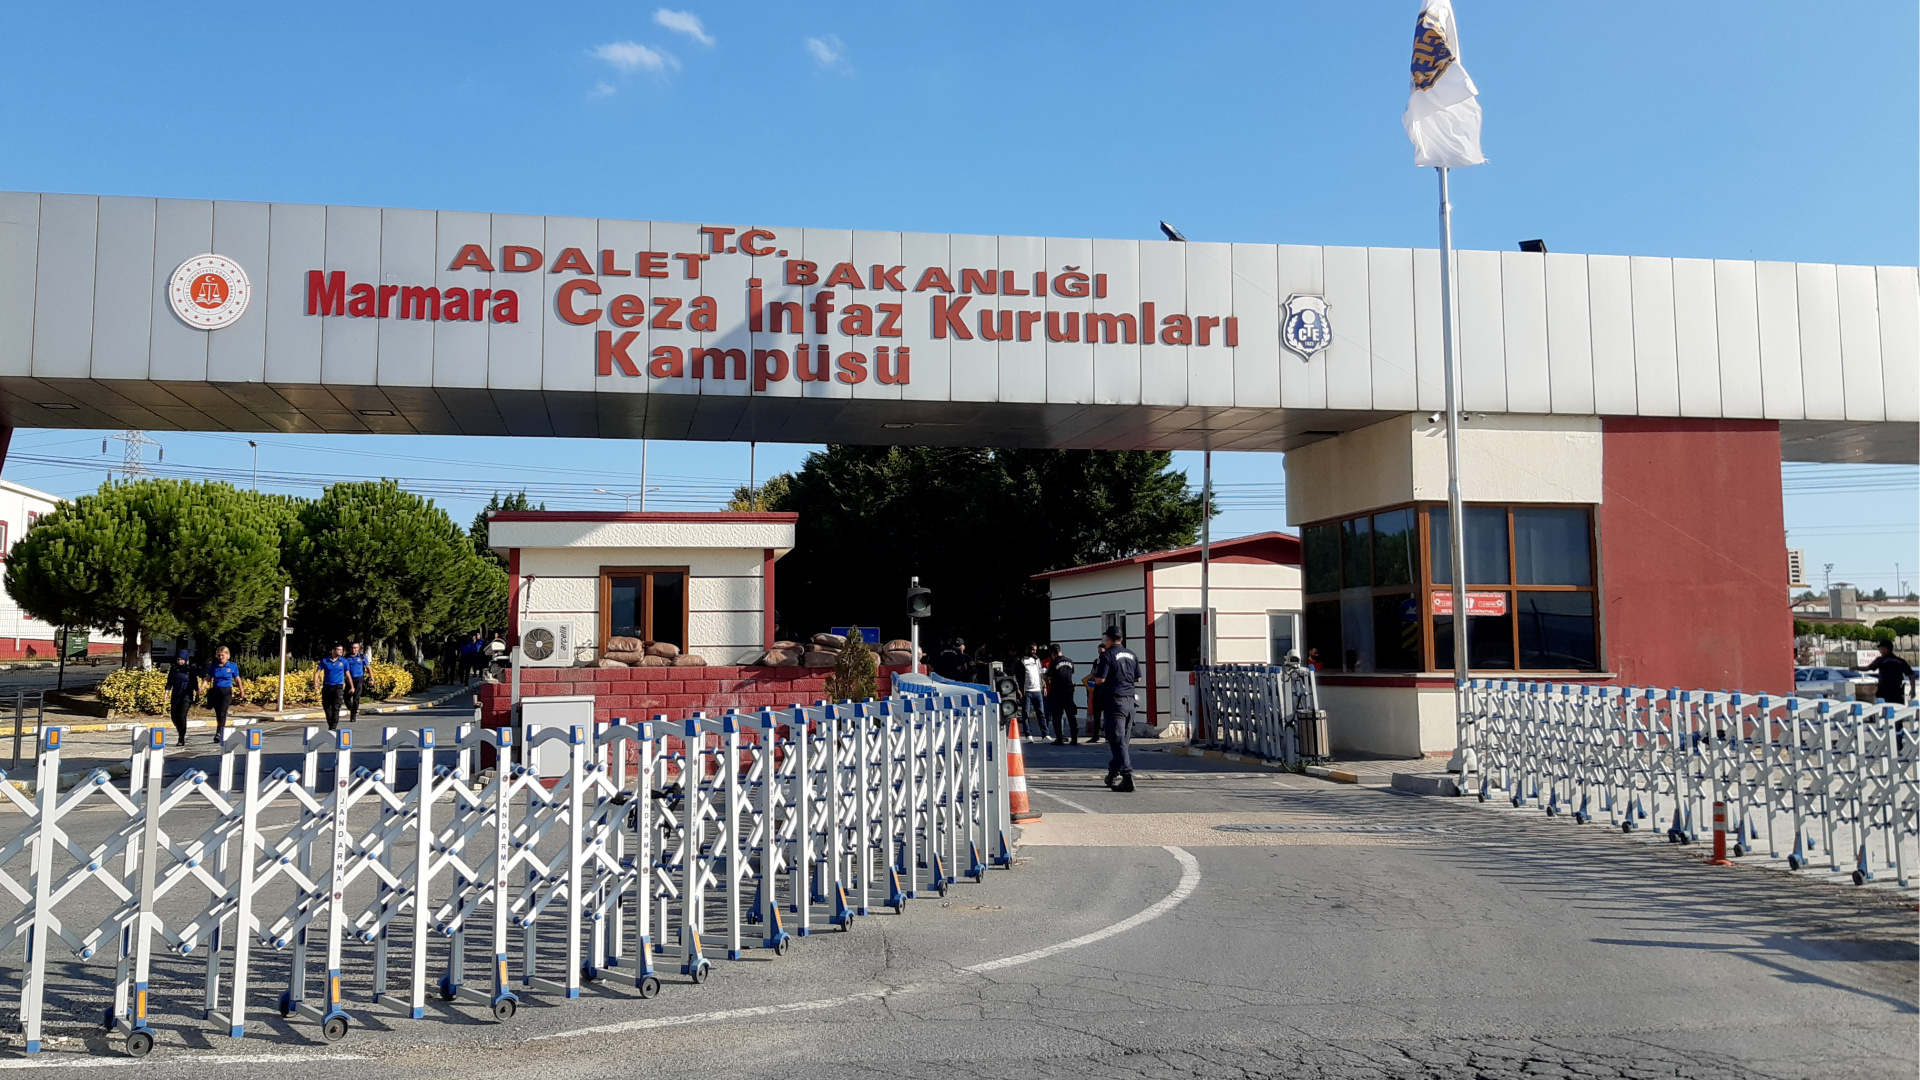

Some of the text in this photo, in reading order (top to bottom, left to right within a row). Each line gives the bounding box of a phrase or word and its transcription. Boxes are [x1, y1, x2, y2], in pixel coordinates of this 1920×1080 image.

[452, 244, 1107, 298] ADALET BAKANLIĞI
[702, 228, 788, 257] T.C.
[307, 270, 1238, 346] Marmara Ceza İnfaz Kurumları
[598, 330, 910, 391] Kampüsü
[559, 625, 568, 651] arçelik
[336, 797, 345, 882] JANDARMA
